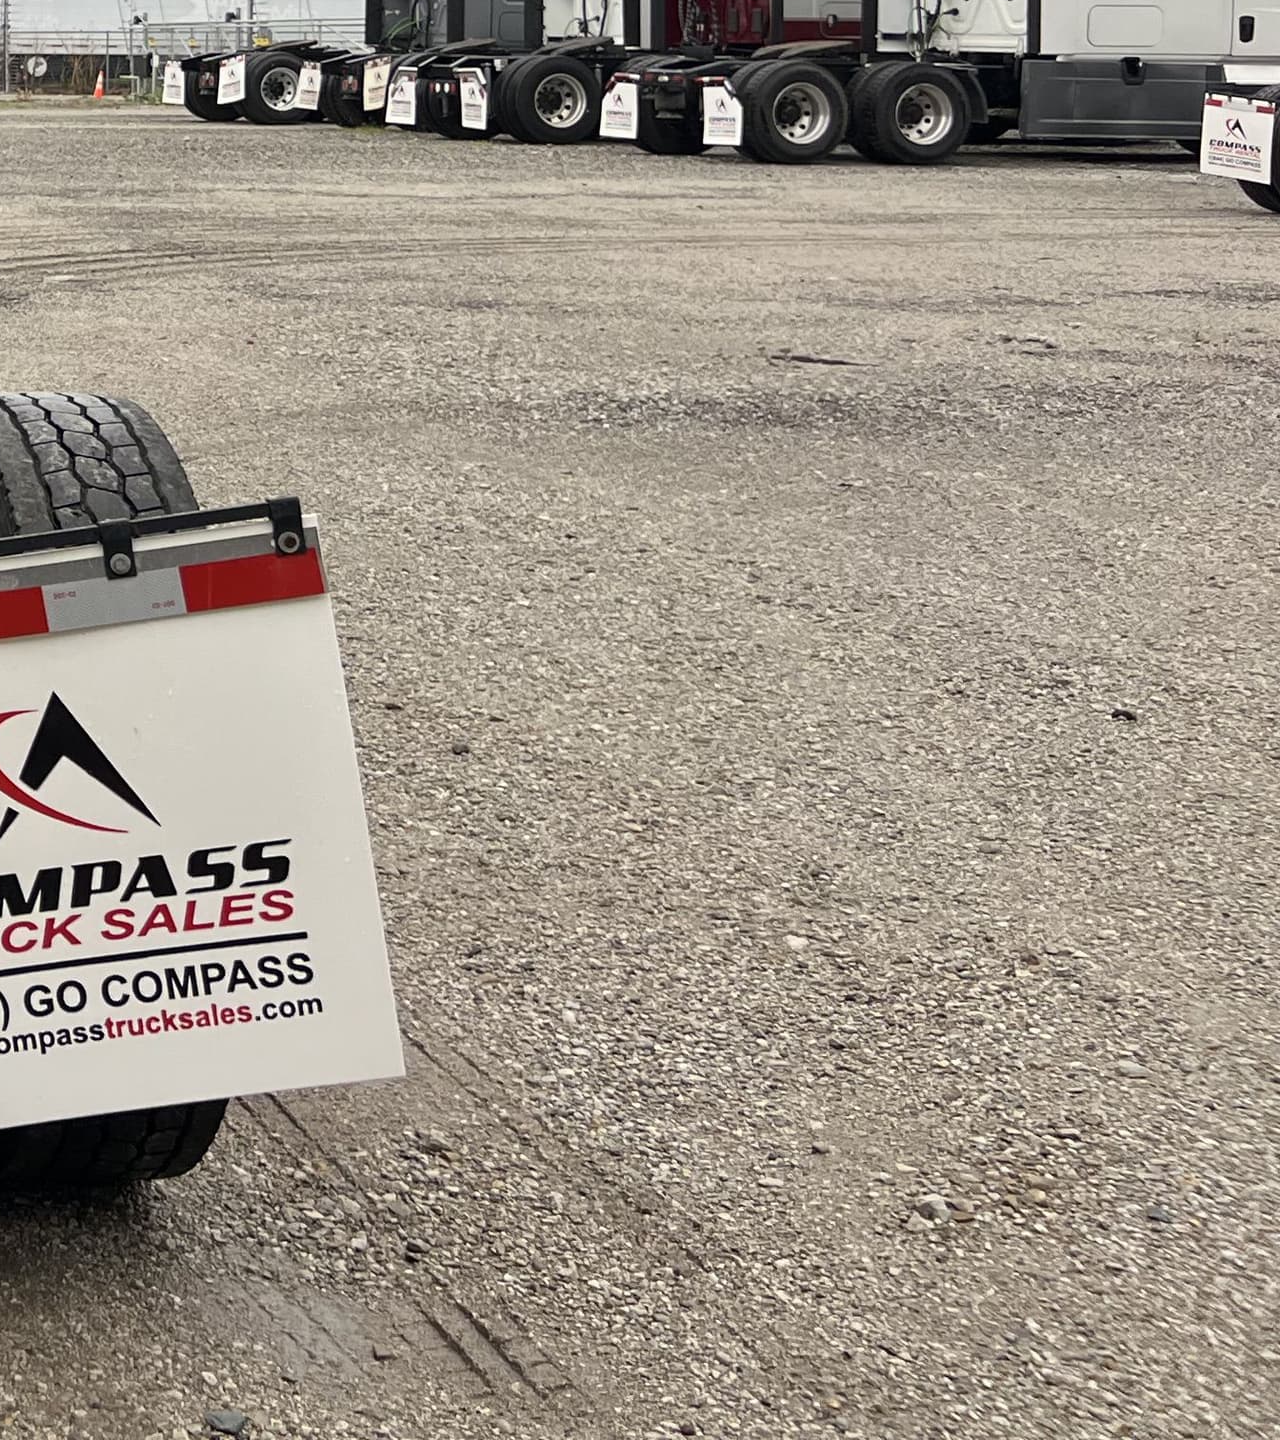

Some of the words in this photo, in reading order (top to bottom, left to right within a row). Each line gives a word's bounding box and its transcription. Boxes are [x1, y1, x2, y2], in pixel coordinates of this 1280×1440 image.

[1209, 139, 1261, 153] COMPASS
[101, 890, 295, 941] SALES
[24, 981, 88, 1017] GO
[101, 952, 314, 1008] COMPASS
